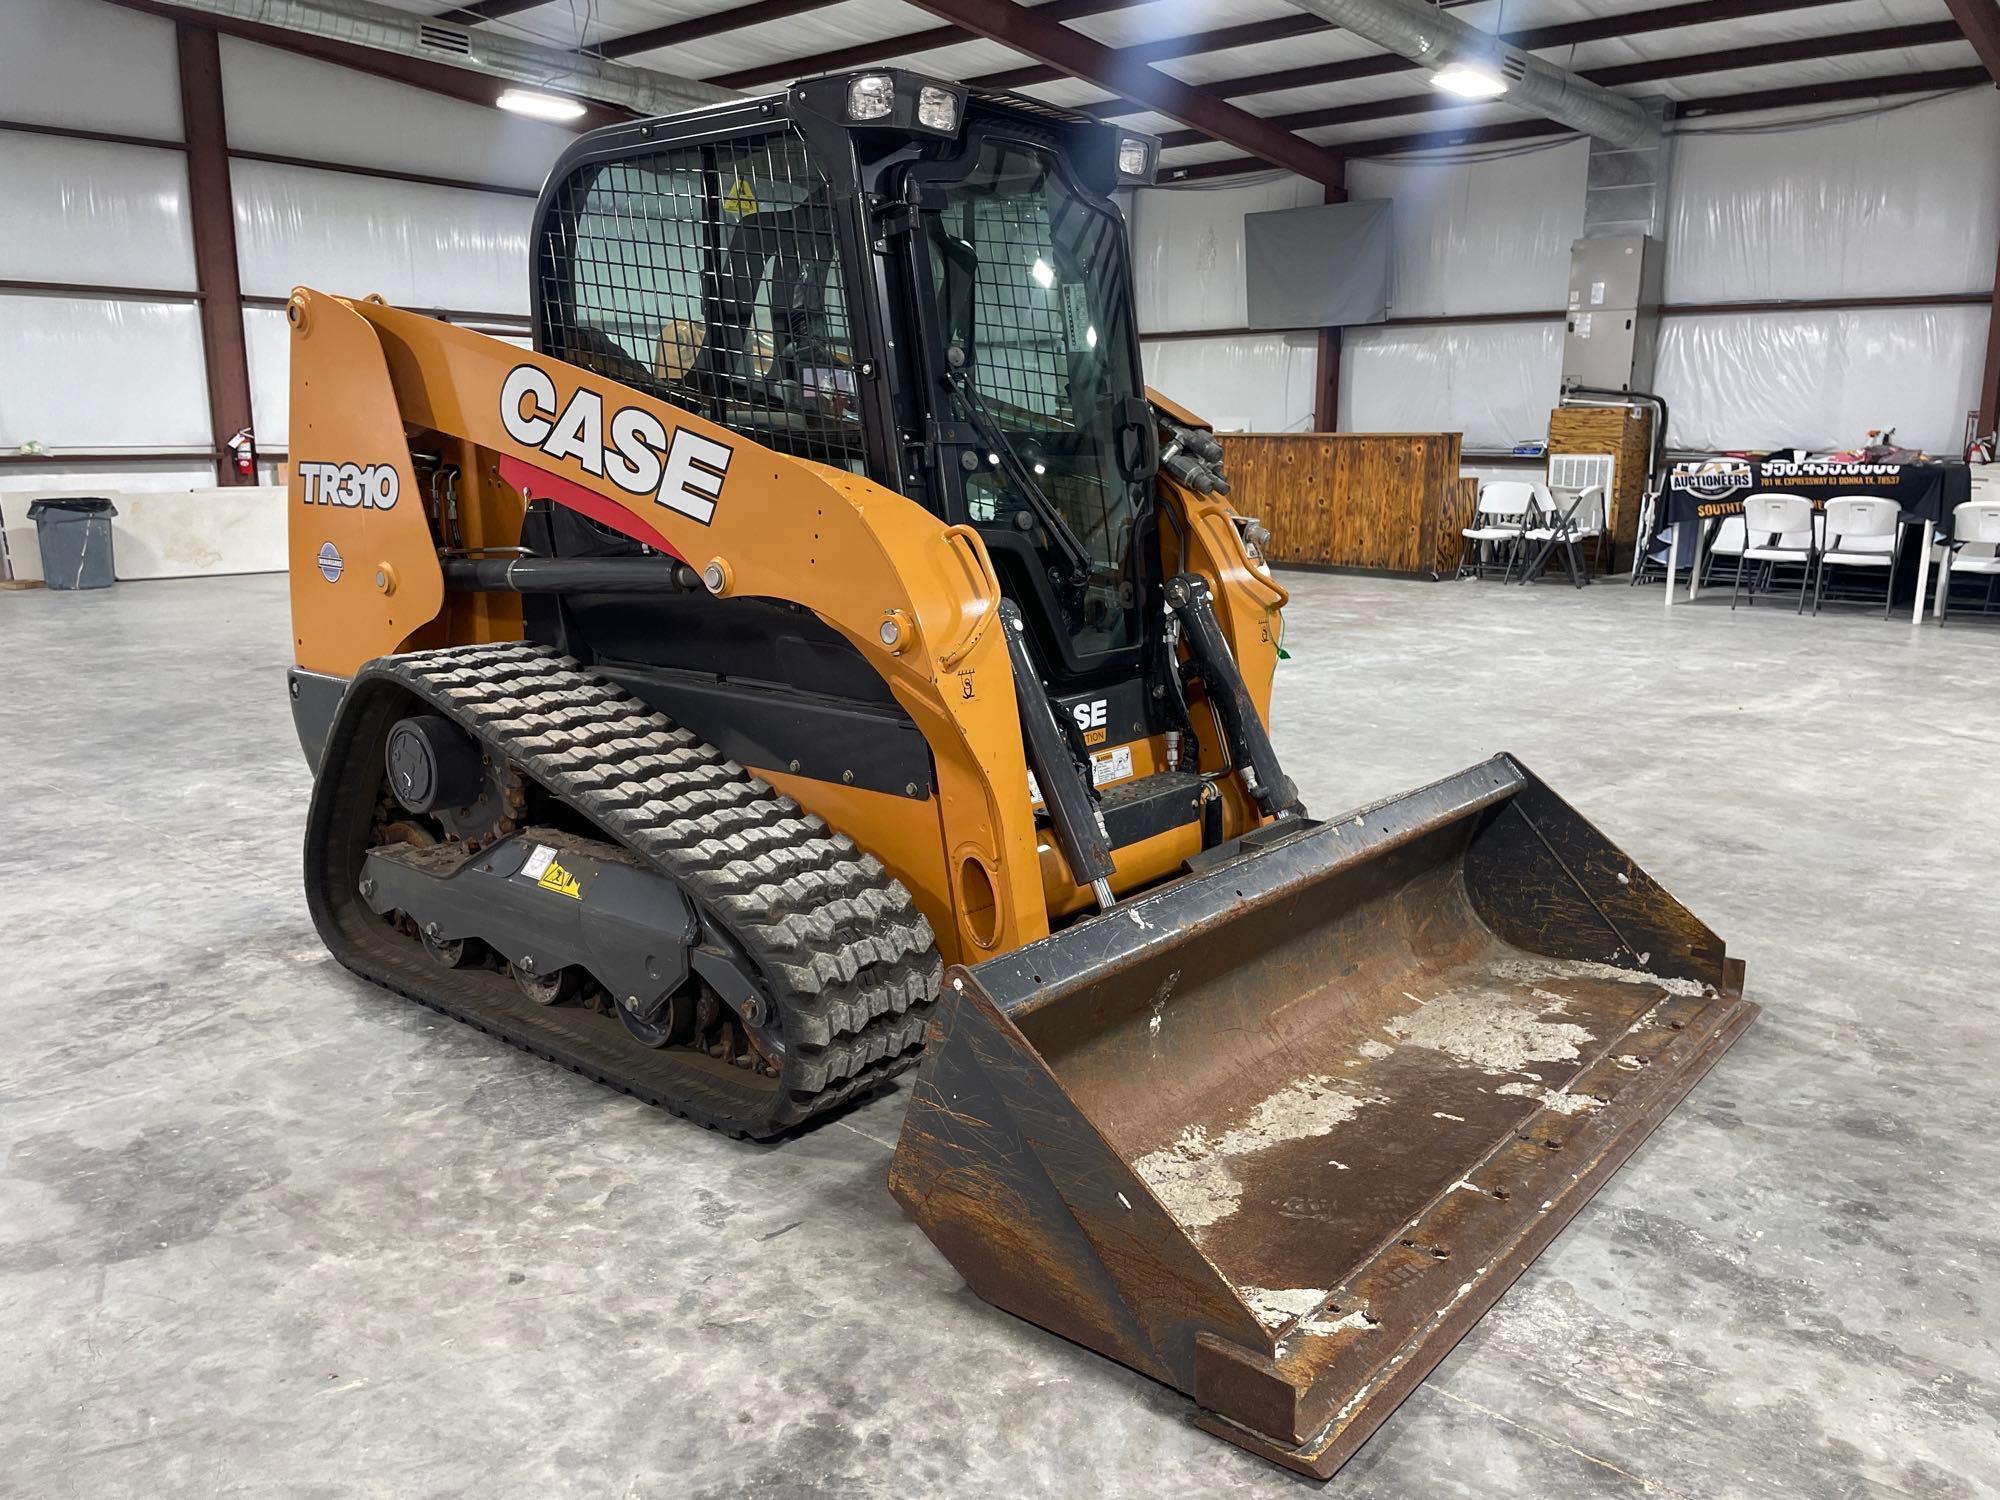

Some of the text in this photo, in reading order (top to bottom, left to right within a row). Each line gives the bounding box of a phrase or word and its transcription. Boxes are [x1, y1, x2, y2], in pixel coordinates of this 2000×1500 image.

[500, 363, 734, 527] CASE
[299, 461, 400, 511] TR310
[1673, 475, 1750, 488] AUCTIONEERS
[1760, 478, 1773, 487] 701
[1784, 477, 1828, 486] EXPRESSWAY
[1839, 476, 1864, 485] DONNA
[1072, 699, 1107, 731] SE
[1085, 732, 1104, 743] TION
